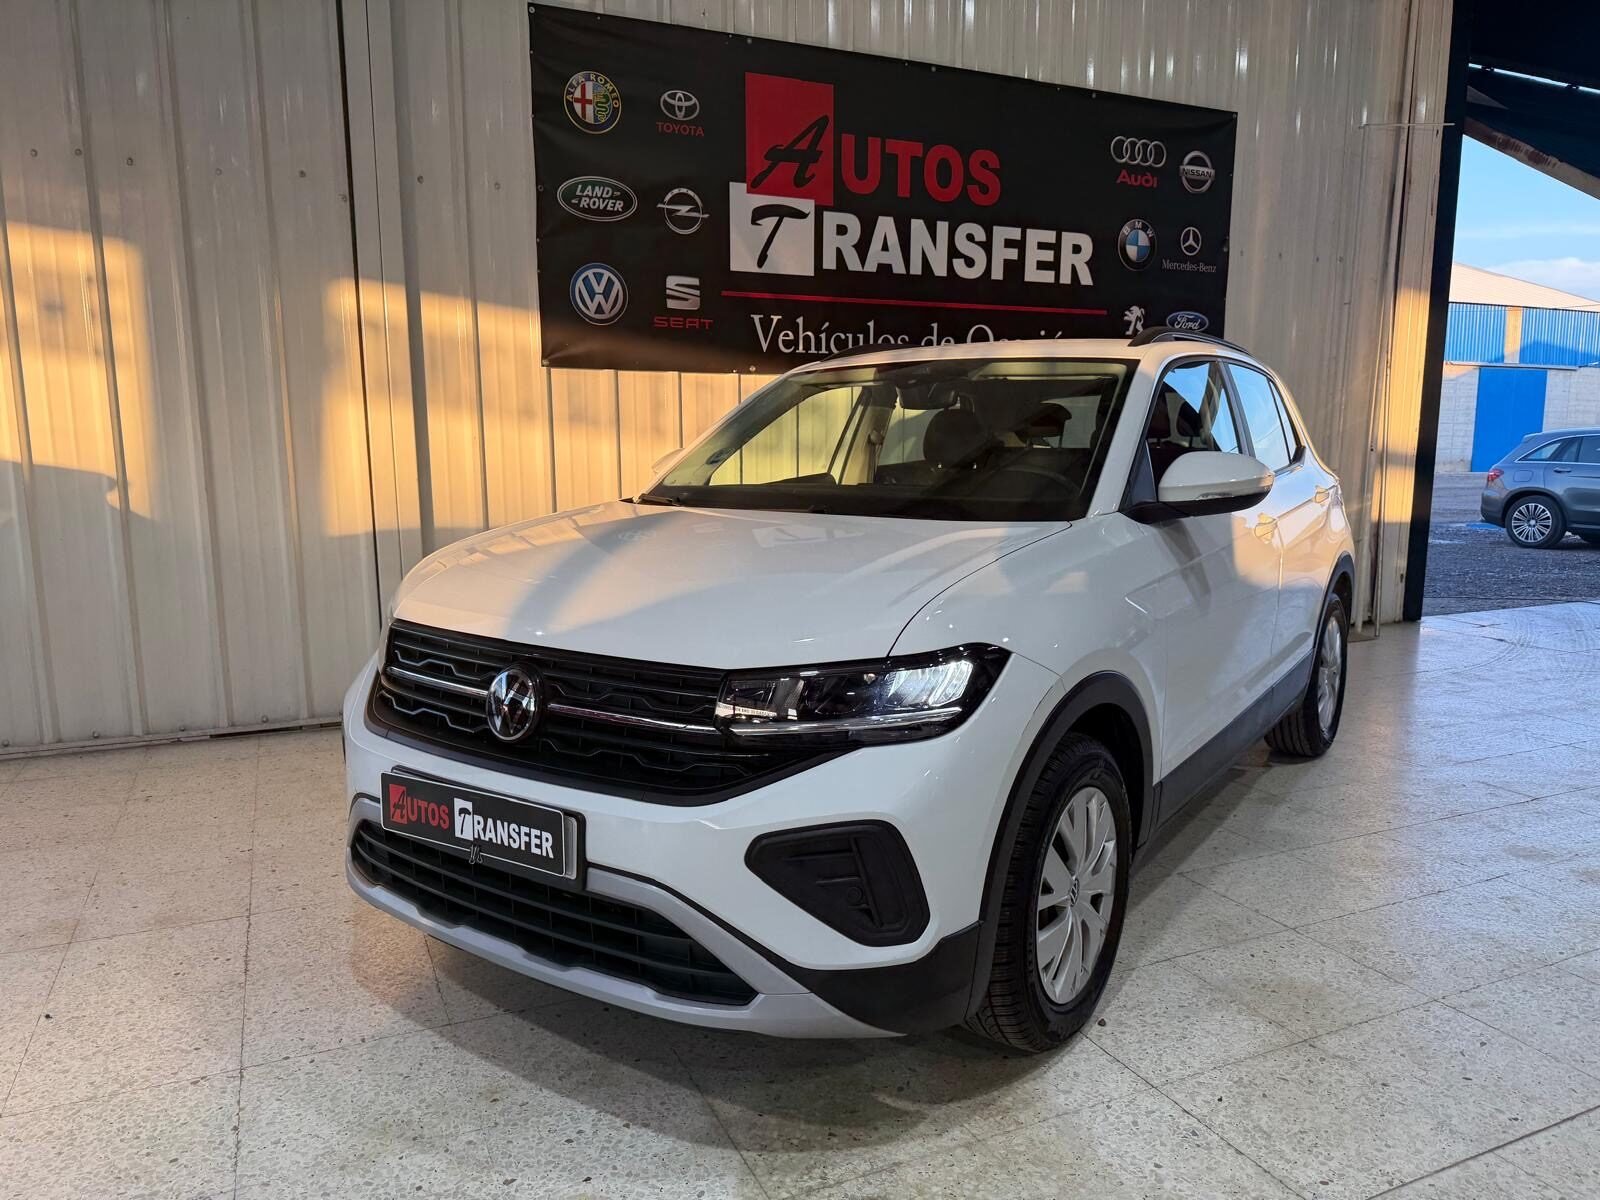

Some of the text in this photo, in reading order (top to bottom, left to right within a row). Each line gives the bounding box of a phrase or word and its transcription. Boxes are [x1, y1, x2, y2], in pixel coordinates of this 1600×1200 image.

[565, 73, 620, 108] ALFA ROMEO
[656, 122, 705, 137] TOYOTA
[750, 114, 1001, 207] AUTOS
[1116, 169, 1158, 188] Audi
[1182, 168, 1212, 178] NISSAN
[576, 184, 613, 197] LAND
[580, 197, 624, 212] ROVER
[750, 203, 1094, 286] TRANSFER
[1162, 259, 1217, 273] Mercedes-Benz
[653, 316, 713, 330] SEAT
[1174, 315, 1201, 330] Ford
[391, 791, 554, 859] AUTOS TRANSFER
